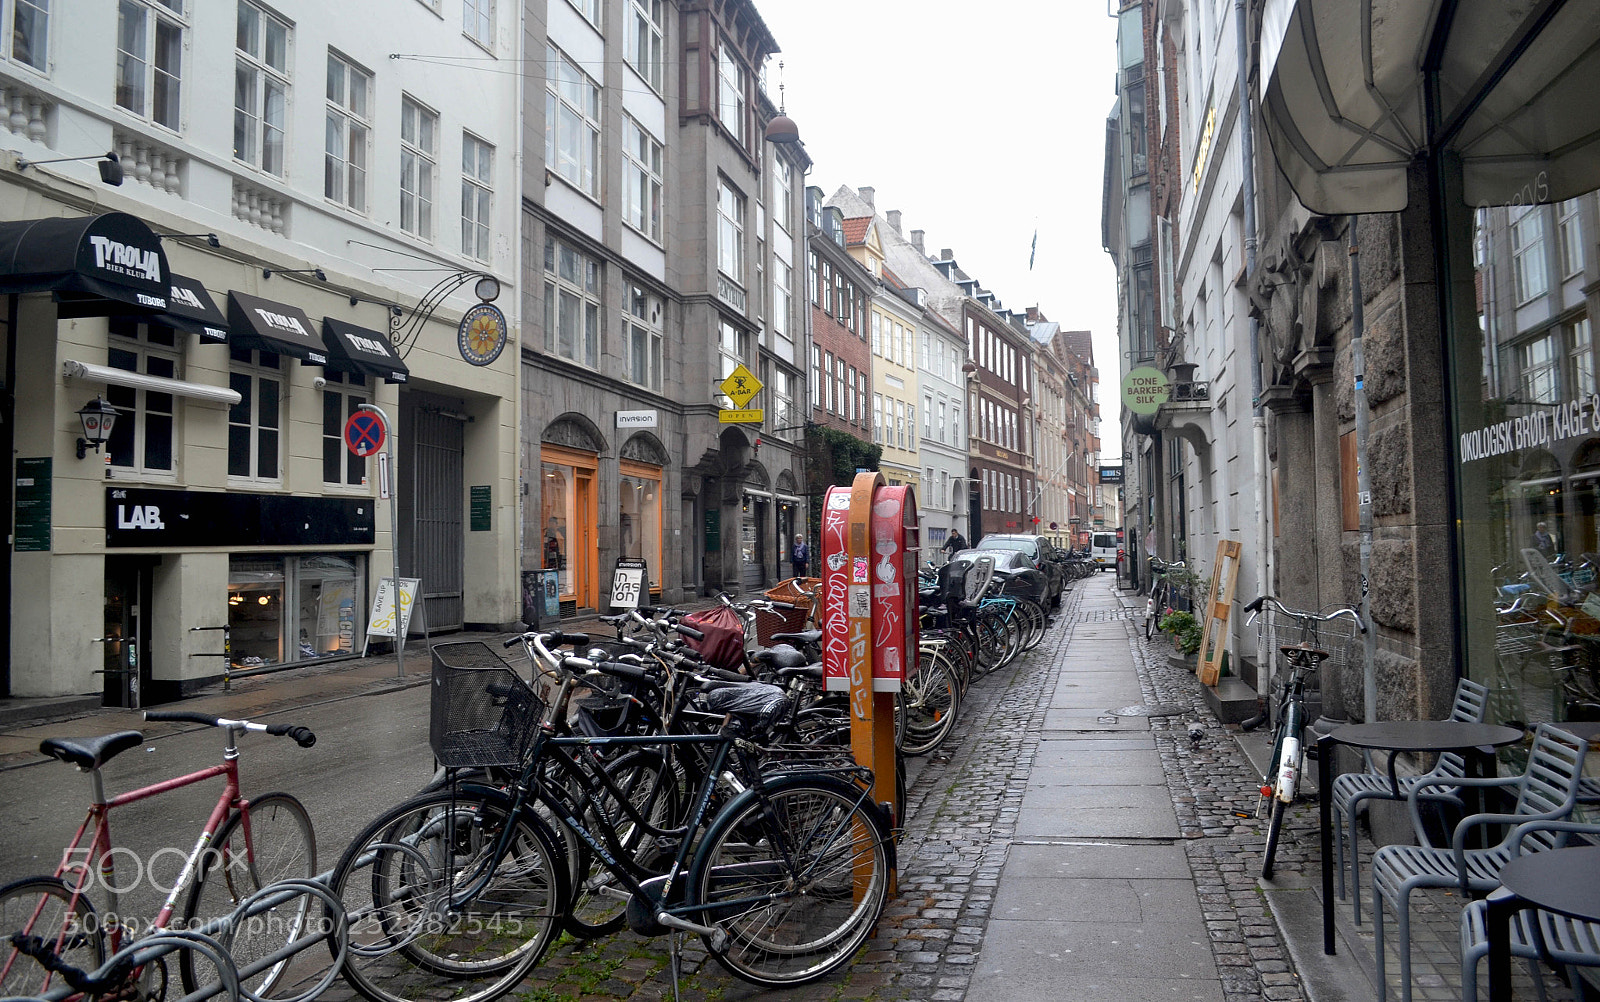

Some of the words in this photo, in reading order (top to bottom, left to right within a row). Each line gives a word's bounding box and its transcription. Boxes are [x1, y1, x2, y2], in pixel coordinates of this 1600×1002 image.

[90, 235, 161, 283] TYROLIA
[106, 263, 124, 274] BIER
[126, 268, 146, 280] KLUB
[137, 293, 167, 309] TUBORG
[717, 276, 744, 311] ENTRUM
[1132, 377, 1158, 386] TONE
[1127, 386, 1163, 395] BARKER
[1136, 396, 1155, 404] SILK
[1461, 420, 1514, 464] ØKOLOGISK
[1515, 410, 1550, 449] BRØD,
[1552, 400, 1589, 441] KAGE
[118, 504, 165, 530] LAB.
[379, 584, 387, 595] UP
[375, 595, 384, 613] SAVE
[565, 815, 616, 866] BATAVUS
